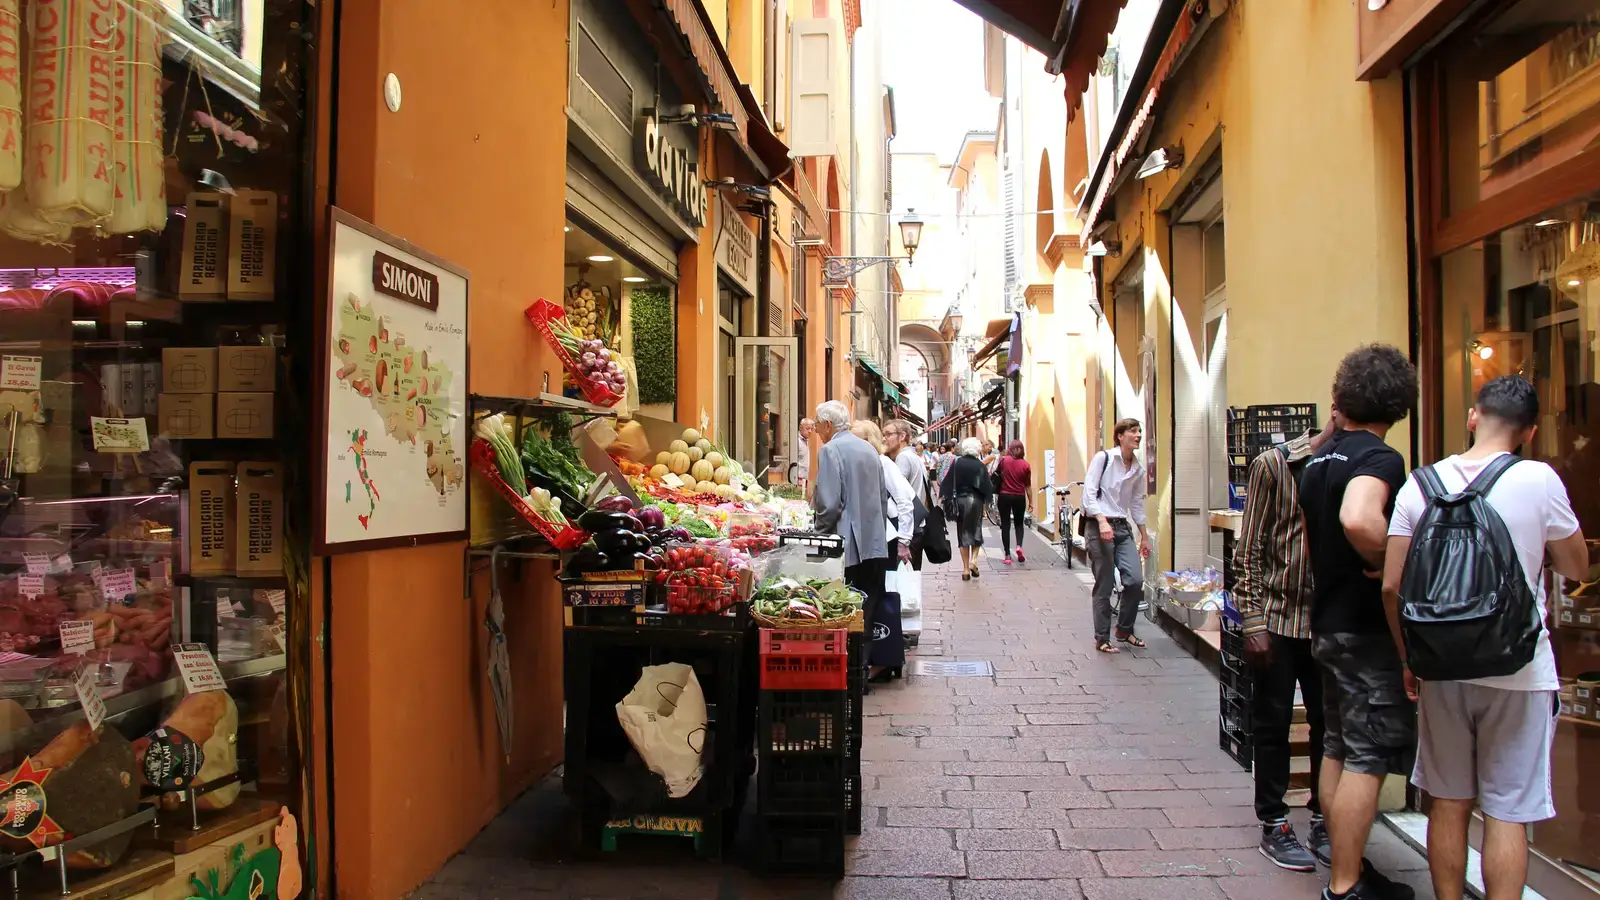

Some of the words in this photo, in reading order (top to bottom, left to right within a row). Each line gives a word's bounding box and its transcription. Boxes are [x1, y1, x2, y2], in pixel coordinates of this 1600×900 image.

[645, 114, 708, 228] davide
[192, 221, 207, 285] PARMIGIANO
[205, 228, 219, 278] REGGIANO
[240, 219, 254, 284] PARMIGIANO
[252, 227, 265, 277] REGGIANO
[381, 261, 432, 304] SIMONI
[200, 489, 213, 558] PARMIGIANO
[212, 496, 225, 550] REGGIANO
[248, 493, 261, 562] PARMIGIANO
[260, 499, 273, 554] REGGIANO
[588, 597, 599, 605] DI
[601, 597, 627, 605] SOLE
[161, 744, 172, 779] VILLANI
[182, 743, 191, 765] Daniele
[182, 765, 190, 777] San
[12, 788, 22, 828] PROSCIUTTO
[18, 788, 28, 828] TOSCANO
